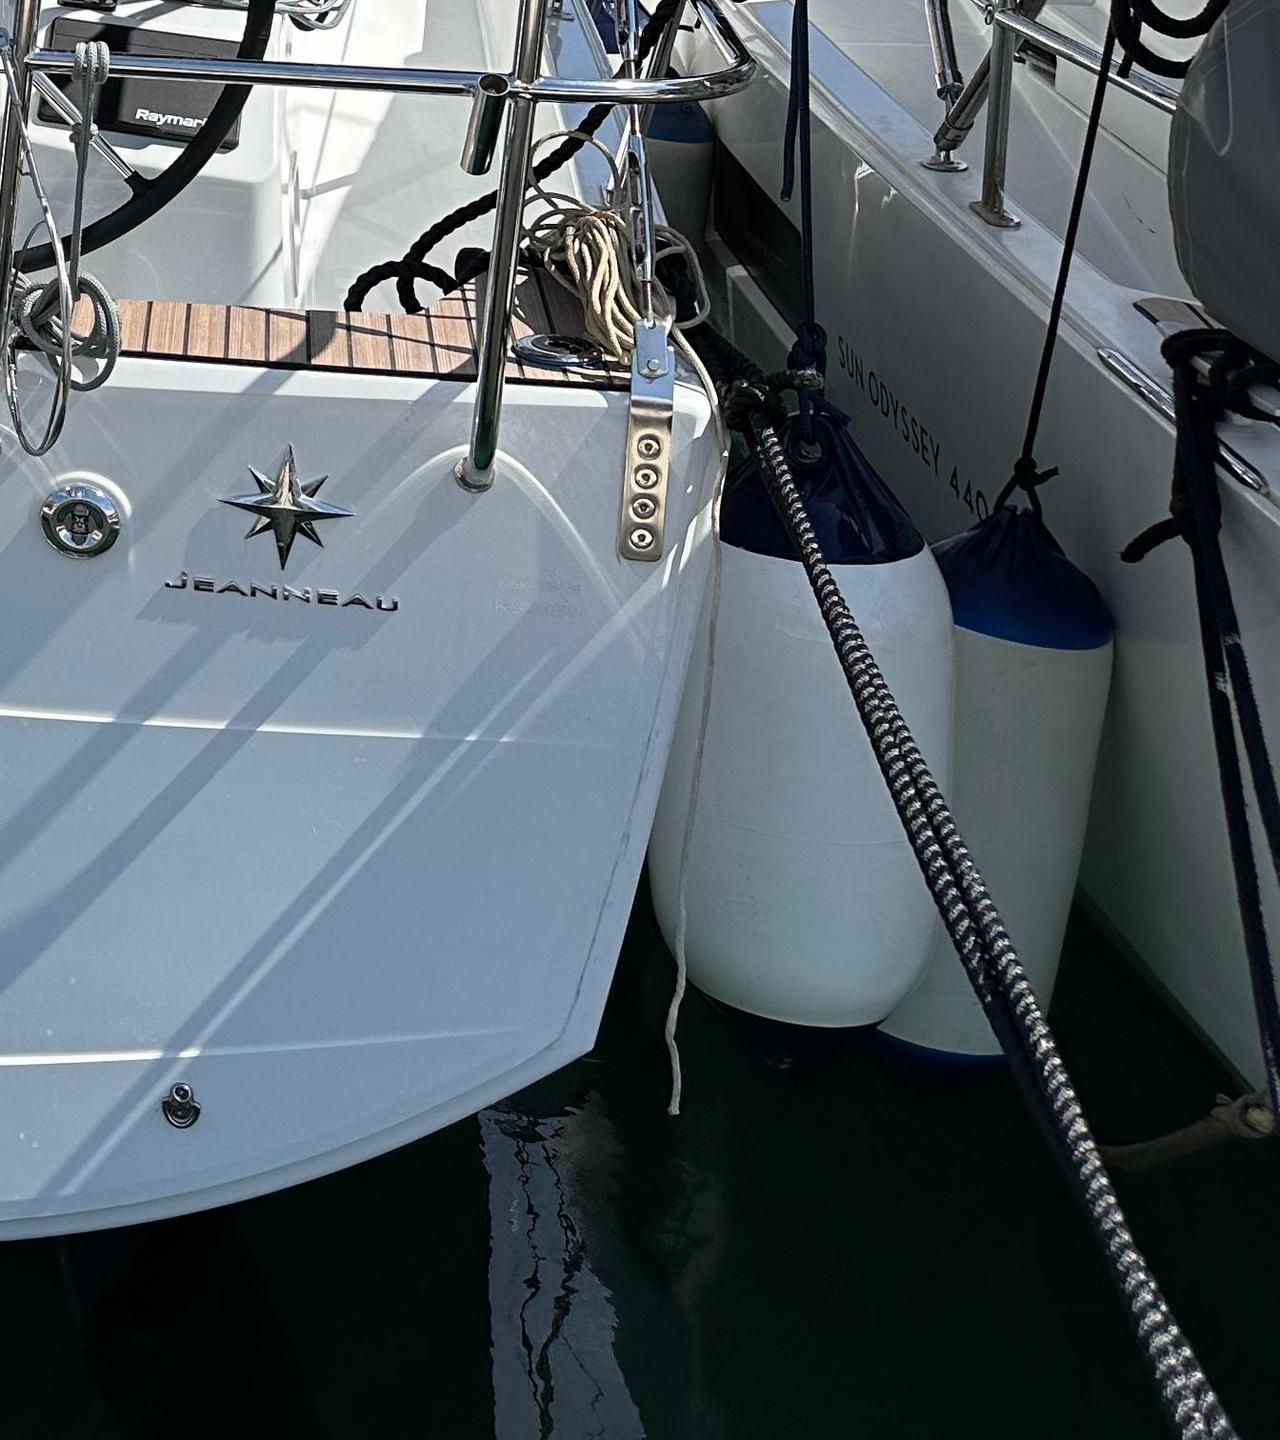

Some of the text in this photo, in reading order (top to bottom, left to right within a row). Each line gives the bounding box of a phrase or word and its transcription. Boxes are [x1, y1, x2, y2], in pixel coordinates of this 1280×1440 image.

[135, 108, 208, 128] Raymari
[839, 335, 989, 521] SUN ODYSSEY 440
[164, 569, 400, 612] JEANNEAU
